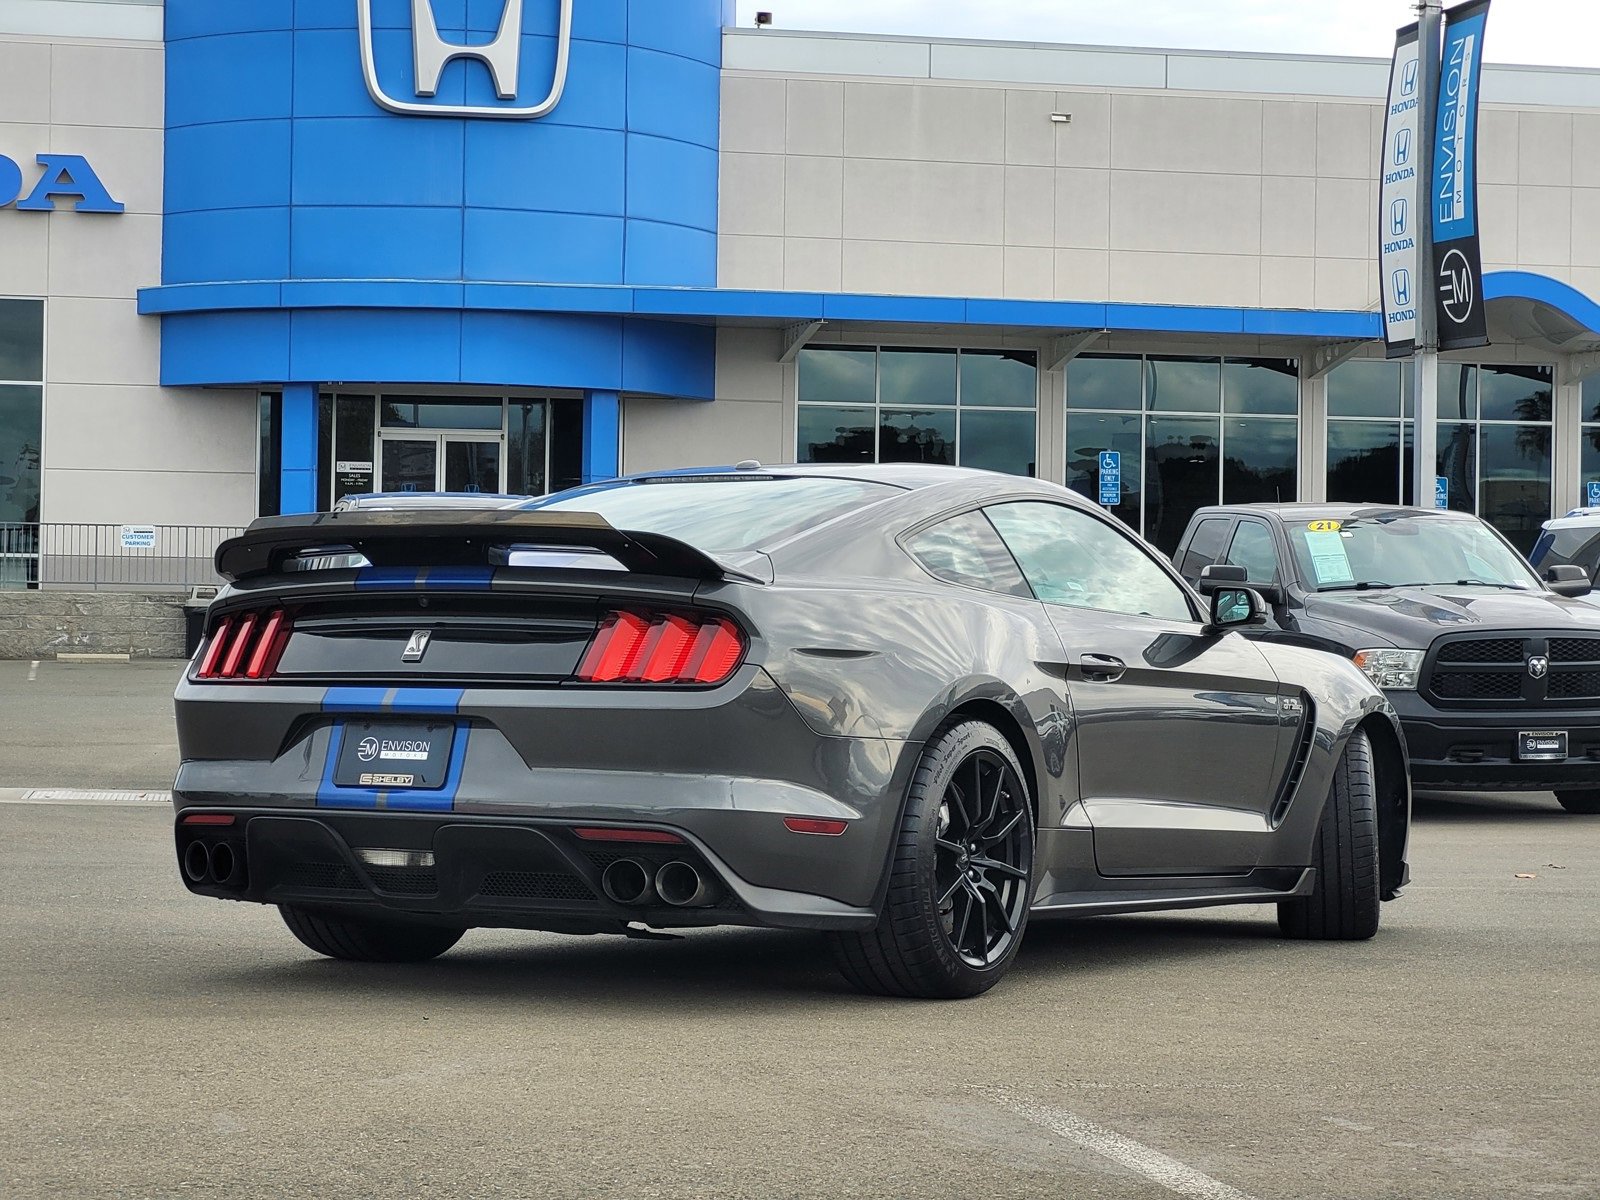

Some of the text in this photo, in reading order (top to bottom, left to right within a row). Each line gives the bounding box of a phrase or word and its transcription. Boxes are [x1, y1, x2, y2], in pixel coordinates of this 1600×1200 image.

[1440, 38, 1465, 223] ENVISION
[1456, 52, 1470, 204] MOTORS
[1384, 167, 1415, 185] HONDA
[1384, 238, 1415, 254] HONDA
[1387, 308, 1416, 324] HOND
[1316, 522, 1332, 530] 21
[381, 740, 431, 752] ENVISION
[372, 776, 412, 784] SHELBY
